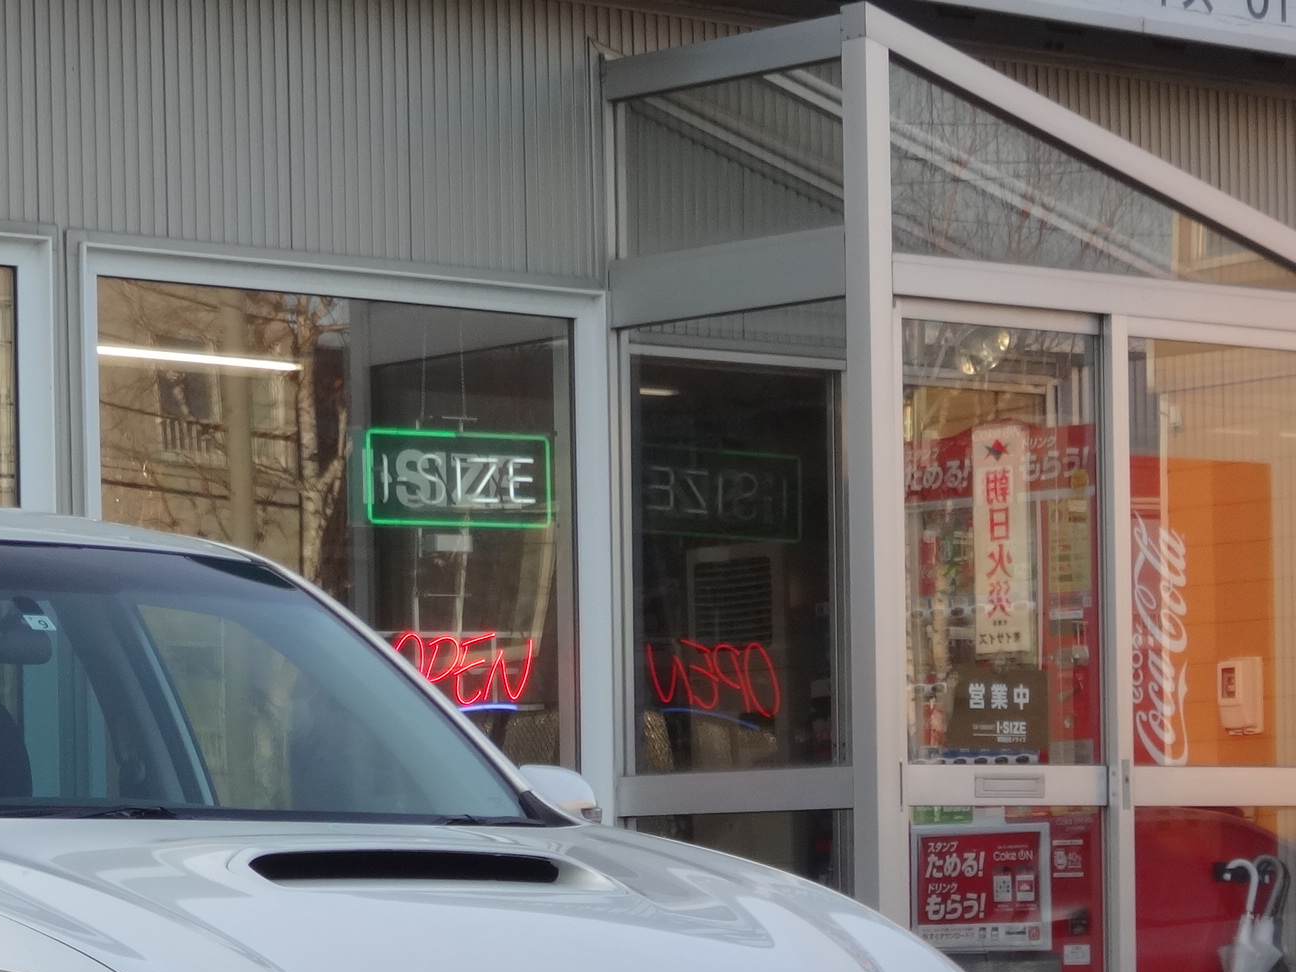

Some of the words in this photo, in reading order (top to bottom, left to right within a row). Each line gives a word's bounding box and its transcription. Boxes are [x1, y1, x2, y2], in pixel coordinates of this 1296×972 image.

[395, 631, 534, 706] OPEN
[968, 682, 1030, 711] 営業中
[928, 840, 959, 853] スタンプ
[993, 851, 1017, 862] Coke
[925, 851, 986, 879] ためる!
[928, 883, 958, 894] ドリンク
[925, 892, 987, 921] もらう!
